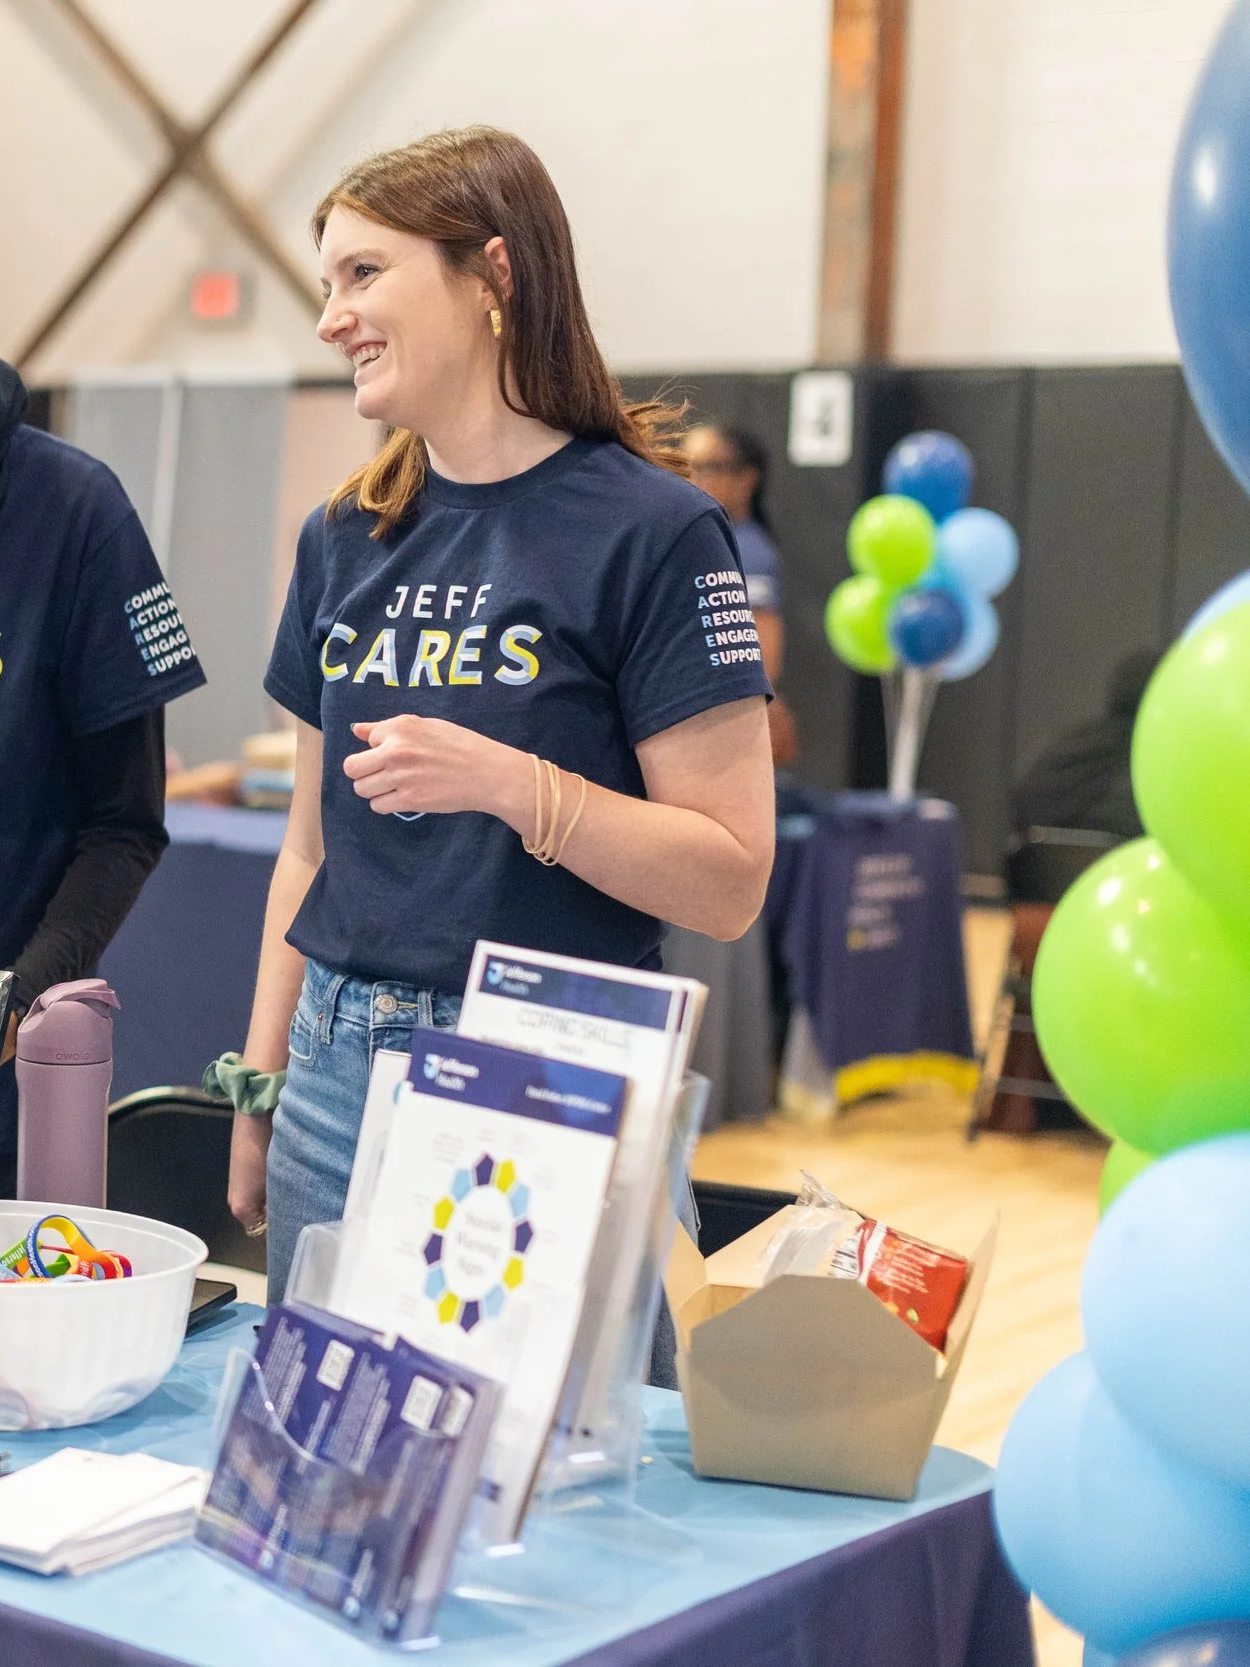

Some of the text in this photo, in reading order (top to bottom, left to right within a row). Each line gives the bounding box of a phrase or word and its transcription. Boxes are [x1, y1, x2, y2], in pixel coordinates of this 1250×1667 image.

[385, 583, 492, 619] JEFF
[697, 590, 746, 609] ACTION
[140, 630, 188, 661] ENGAG
[319, 622, 543, 687] CARES
